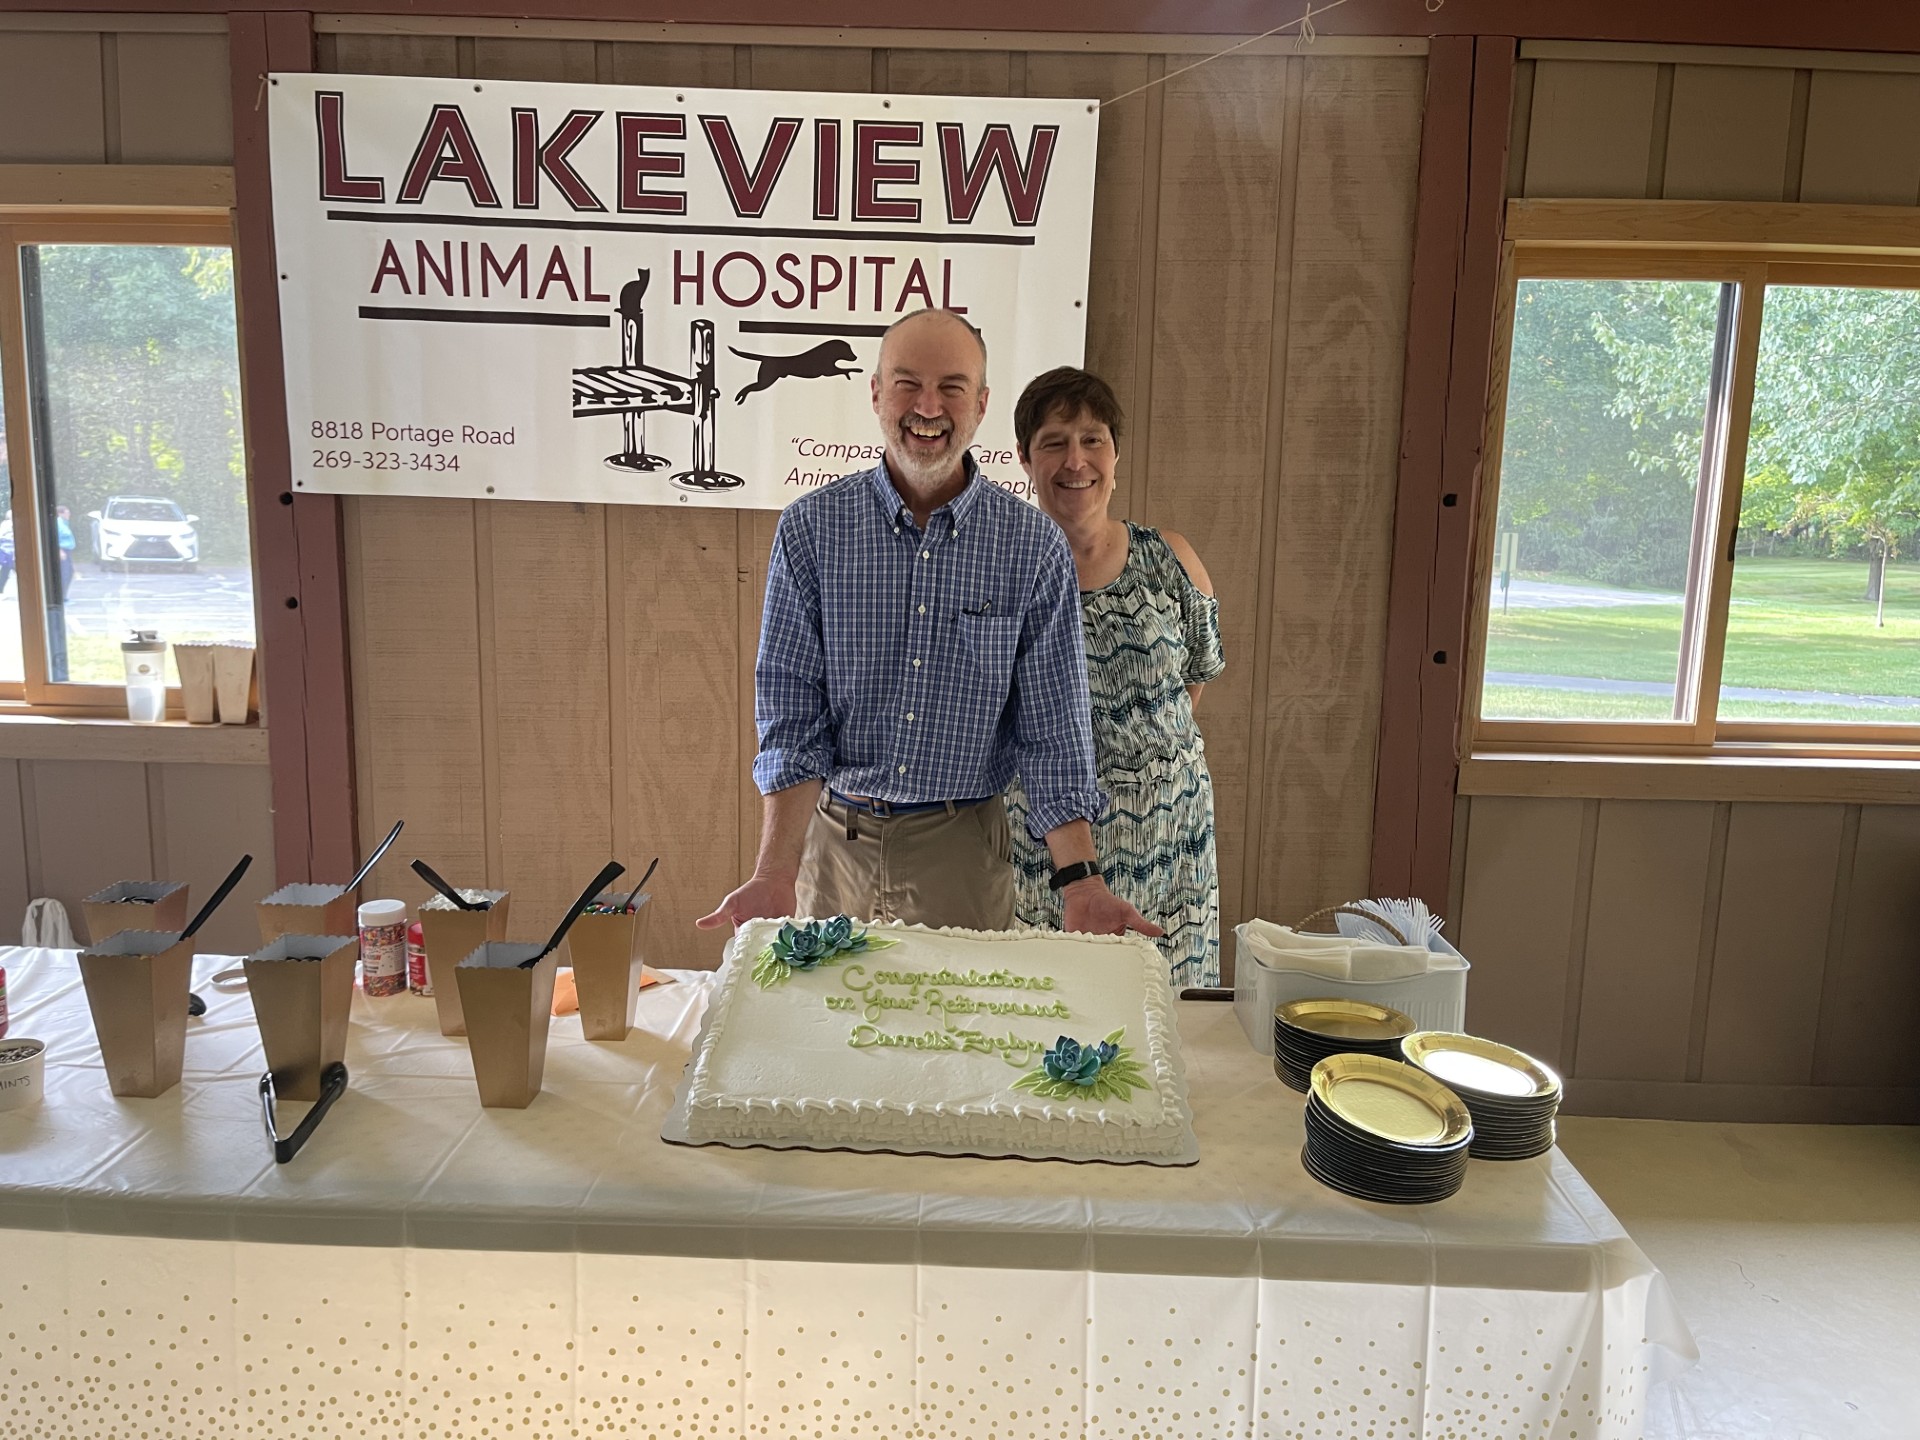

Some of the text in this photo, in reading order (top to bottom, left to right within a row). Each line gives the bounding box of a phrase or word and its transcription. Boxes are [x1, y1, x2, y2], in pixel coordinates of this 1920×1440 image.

[315, 90, 1060, 227] LAKEVIEW
[370, 238, 968, 315] ANIMAL HOSPITAL
[311, 420, 516, 447] 8818 Portage Road
[312, 449, 461, 472] 269-323-3434
[791, 437, 884, 463] “Compas
[784, 466, 860, 487] Anim
[842, 964, 1055, 997] Congratulations
[824, 996, 857, 1011] on
[923, 988, 1071, 1033] Retirement
